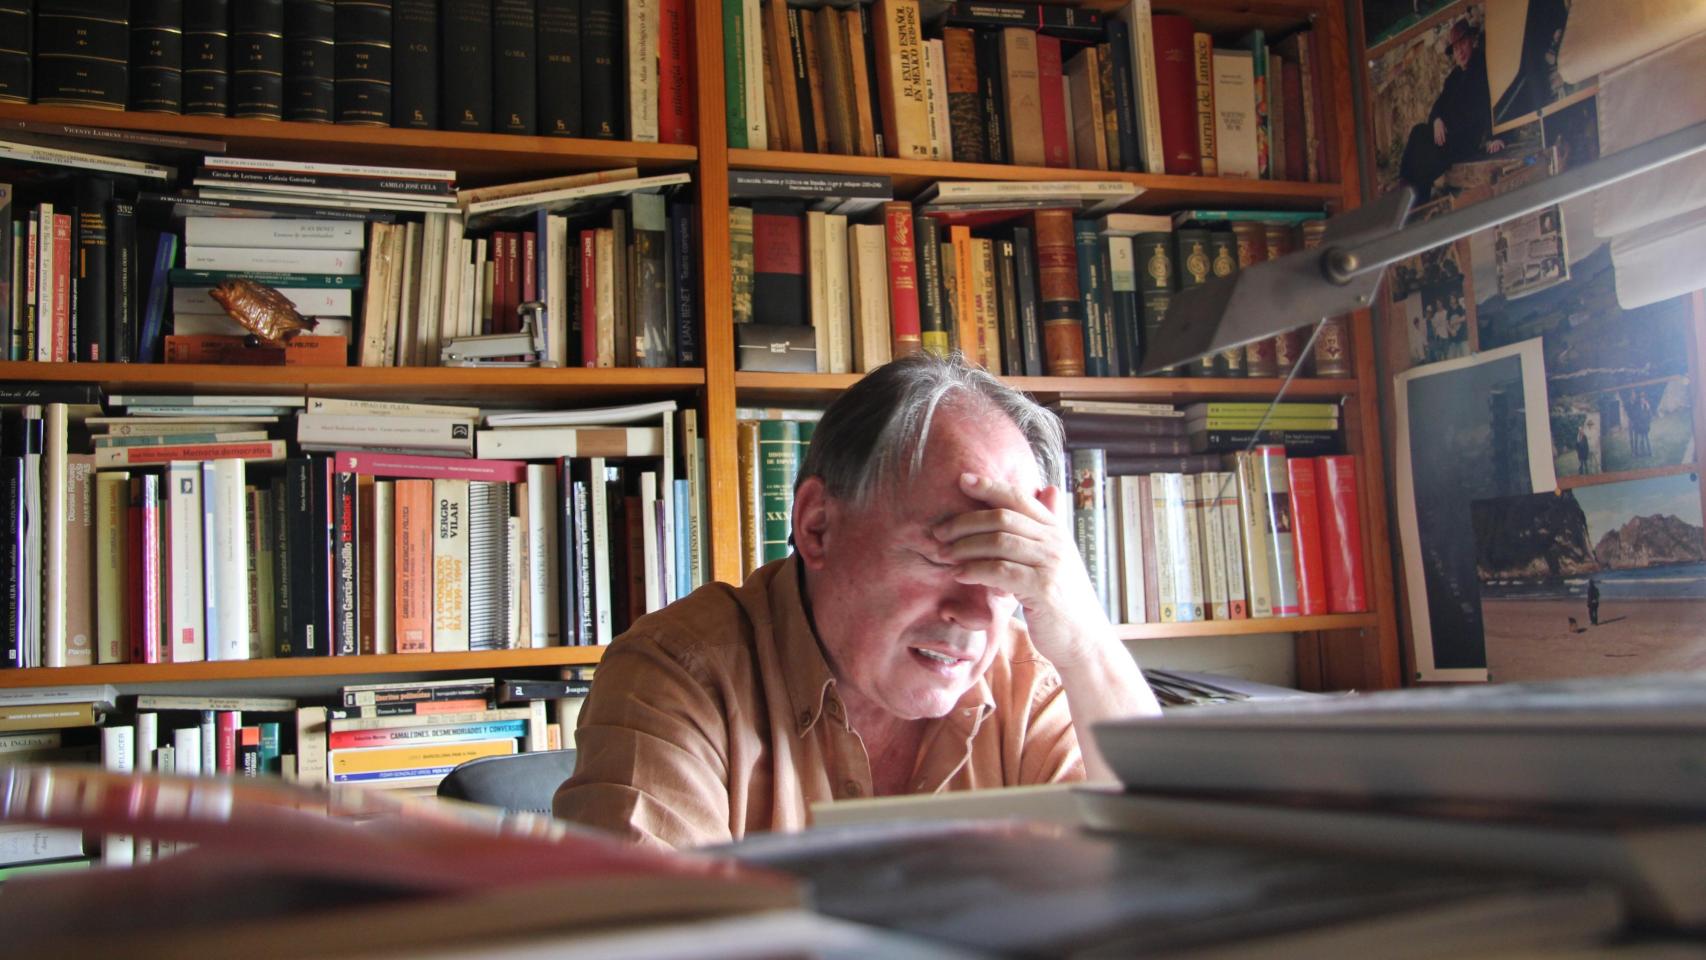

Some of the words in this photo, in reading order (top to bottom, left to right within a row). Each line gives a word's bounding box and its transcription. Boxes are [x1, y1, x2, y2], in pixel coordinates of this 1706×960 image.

[896, 6, 909, 47] ESPAÑOL
[901, 49, 911, 81] EXILIO
[903, 84, 912, 97] EL
[913, 89, 923, 102] EN
[1198, 91, 1210, 109] de
[1199, 111, 1216, 159] Journal
[681, 288, 690, 318] BENET
[682, 320, 691, 346] JUAN
[340, 495, 351, 532] Balance
[440, 499, 449, 539] SERGIO
[450, 502, 459, 538] VILAR
[341, 533, 352, 542] El
[341, 542, 354, 611] García-Abadillo
[343, 612, 354, 653] Casimiro
[436, 616, 445, 631] LA
